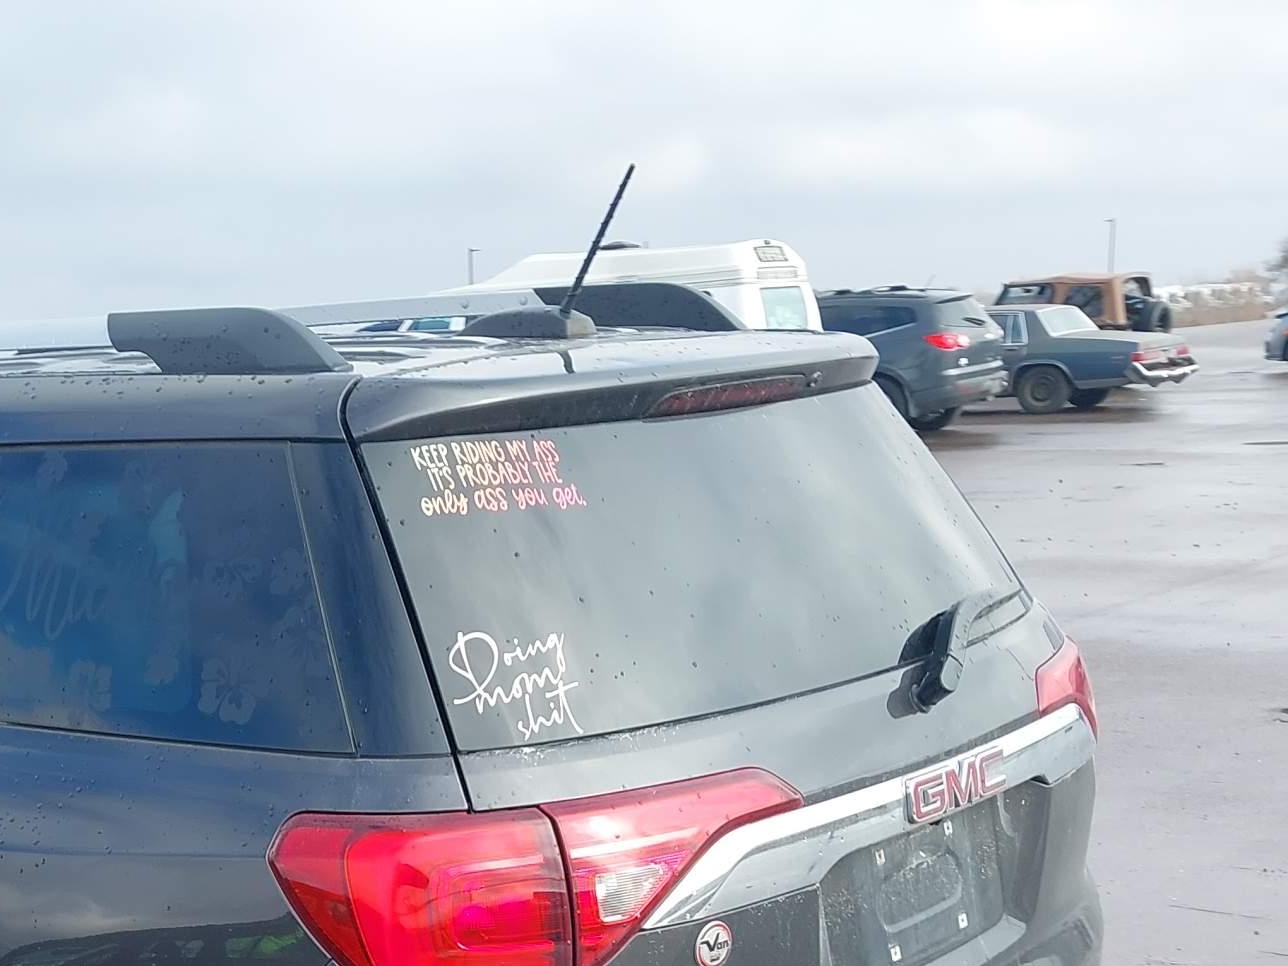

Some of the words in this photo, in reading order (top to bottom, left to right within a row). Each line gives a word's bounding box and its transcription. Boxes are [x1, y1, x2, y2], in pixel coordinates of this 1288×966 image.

[411, 442, 448, 471] KEEP
[451, 440, 505, 465] RIDING
[505, 440, 531, 462] MY
[533, 440, 560, 462] ASS
[457, 460, 533, 488] PROBABLY
[533, 460, 562, 484] THE
[420, 489, 468, 516] only
[474, 487, 508, 511] ass
[512, 487, 548, 509] you
[449, 631, 565, 705] Doing
[475, 667, 559, 714] mom
[517, 680, 584, 741] shit
[907, 745, 1008, 824] GMC
